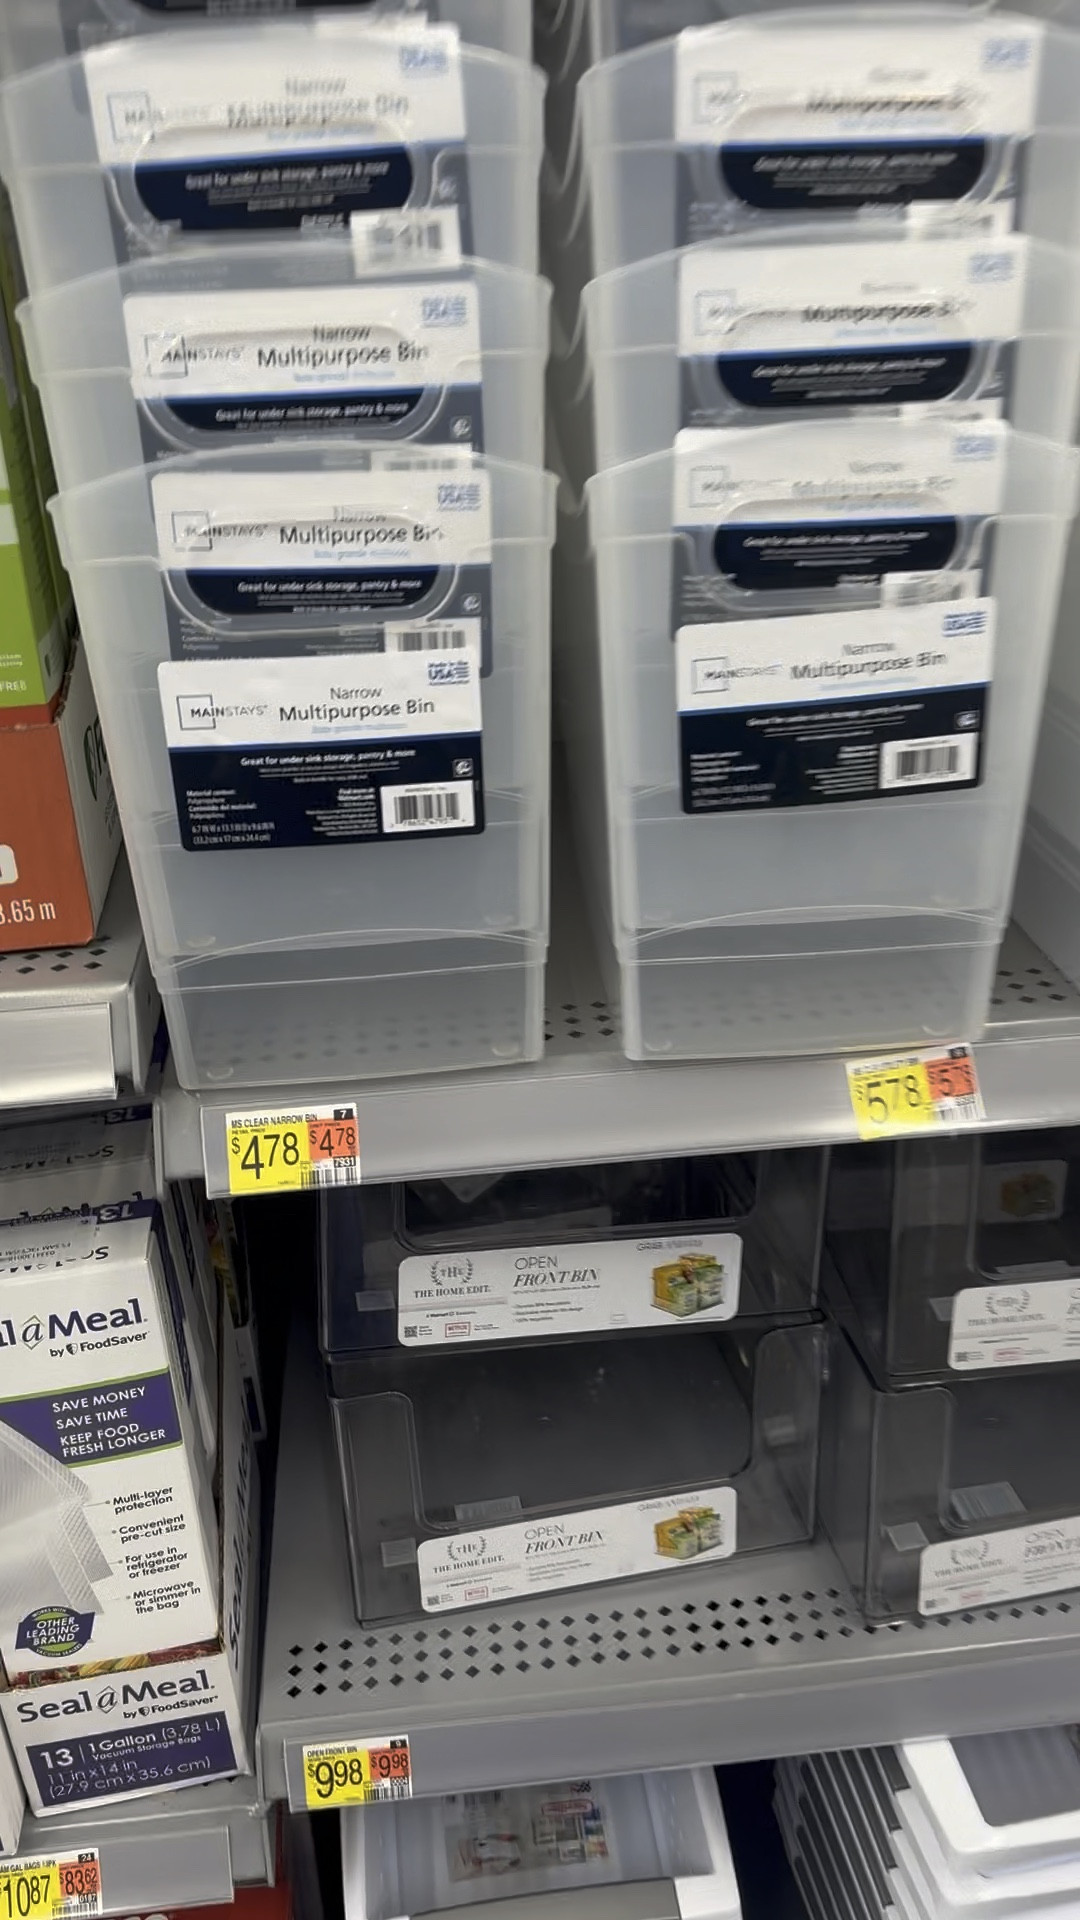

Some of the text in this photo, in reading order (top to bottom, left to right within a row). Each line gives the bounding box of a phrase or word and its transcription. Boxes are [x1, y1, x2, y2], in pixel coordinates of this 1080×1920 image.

[257, 346, 390, 370] Multipurpose
[279, 526, 407, 546] Multipurpose
[791, 657, 913, 680] Multipurpose
[330, 686, 383, 700] Narrow
[190, 705, 264, 718] MAINSTAYS
[279, 698, 435, 723] Multipurpose Bin
[240, 757, 264, 767] Great
[265, 756, 278, 765] for
[39, 902, 56, 920] m
[231, 1113, 318, 1129] MS CLEAR NARROW BIN
[514, 1256, 558, 1272] OPEN
[514, 1269, 570, 1288] FRONT
[413, 1288, 435, 1299] THE
[436, 1286, 465, 1298] HOME
[49, 1331, 148, 1358] by FoodSaver
[52, 1386, 146, 1413] SAVE MONEY
[56, 1407, 129, 1430] SAVE TIME
[59, 1423, 140, 1447] KEEP FOOD
[62, 1429, 166, 1458] FRESH LONGER
[112, 1487, 174, 1507] Multi-layer
[115, 1495, 174, 1515] protection
[118, 1513, 185, 1535] Convenient
[121, 1521, 186, 1545] pre-cut size
[525, 1530, 605, 1555] FRONT BIN
[125, 1545, 178, 1564] For use in
[127, 1550, 189, 1573] refrigerator
[128, 1561, 182, 1580] or freezer
[433, 1563, 453, 1575] THE
[453, 1559, 482, 1572] HOME
[133, 1579, 195, 1601] Microwave
[135, 1586, 201, 1607] or simmer in
[136, 1598, 180, 1615] the bag
[26, 1624, 80, 1639] LEADING
[36, 1616, 75, 1629] OTHER
[33, 1633, 75, 1646] BRAND
[17, 1691, 93, 1723] Seal
[123, 1697, 215, 1719] by FoodSaver
[40, 1748, 74, 1769] 13
[99, 1733, 156, 1751] Gallon
[161, 1723, 201, 1741] (3.78
[205, 1718, 221, 1732] L)
[92, 1735, 202, 1761] Vacuum Storage Bags
[307, 1750, 325, 1758] OPEN
[49, 1780, 89, 1799] (27.9
[94, 1776, 124, 1790] cm
[139, 1765, 174, 1781] 35.6
[177, 1756, 211, 1773] cm)
[71, 1769, 86, 1782] in
[123, 1759, 138, 1771] in
[0, 1874, 51, 1918] 1087
